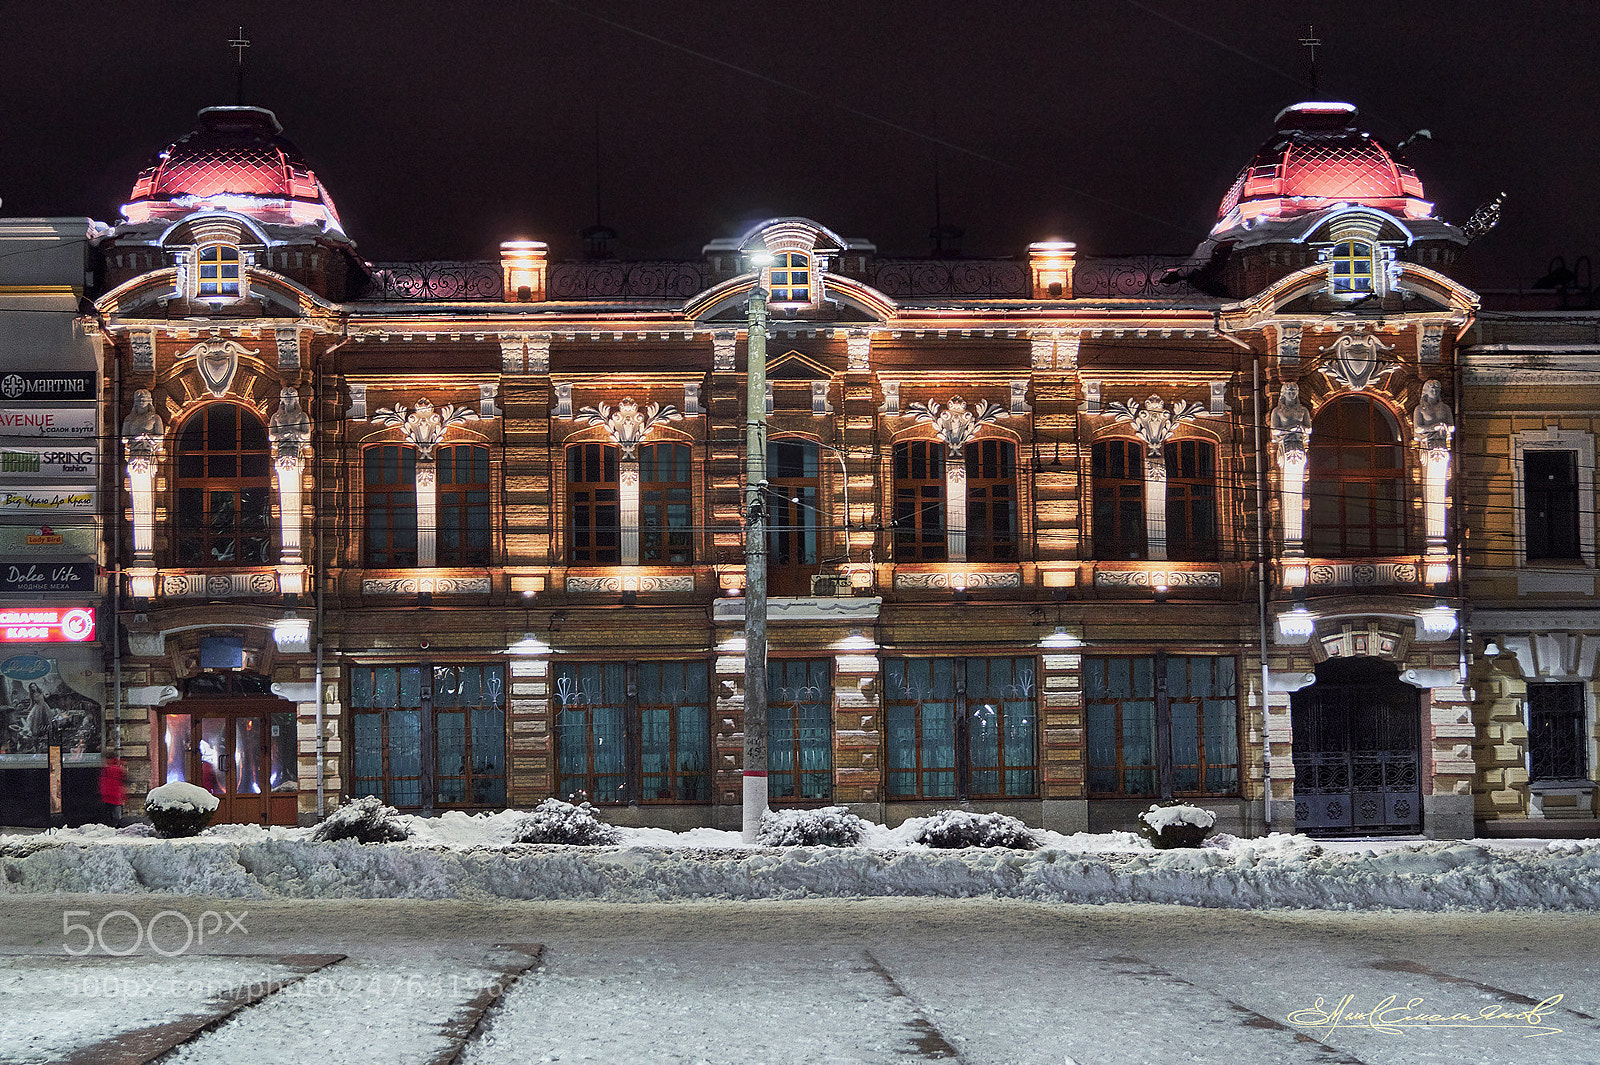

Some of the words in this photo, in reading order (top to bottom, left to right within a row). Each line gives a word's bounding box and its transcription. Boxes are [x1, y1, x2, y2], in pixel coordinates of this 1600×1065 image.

[43, 451, 93, 465] SPRING
[62, 464, 87, 472] fashion
[25, 494, 49, 508] Краю
[50, 495, 65, 509] До
[67, 494, 91, 508] Краю
[6, 565, 46, 583] Dolce
[51, 566, 81, 583] Vita
[7, 627, 49, 638] КАФЕ
